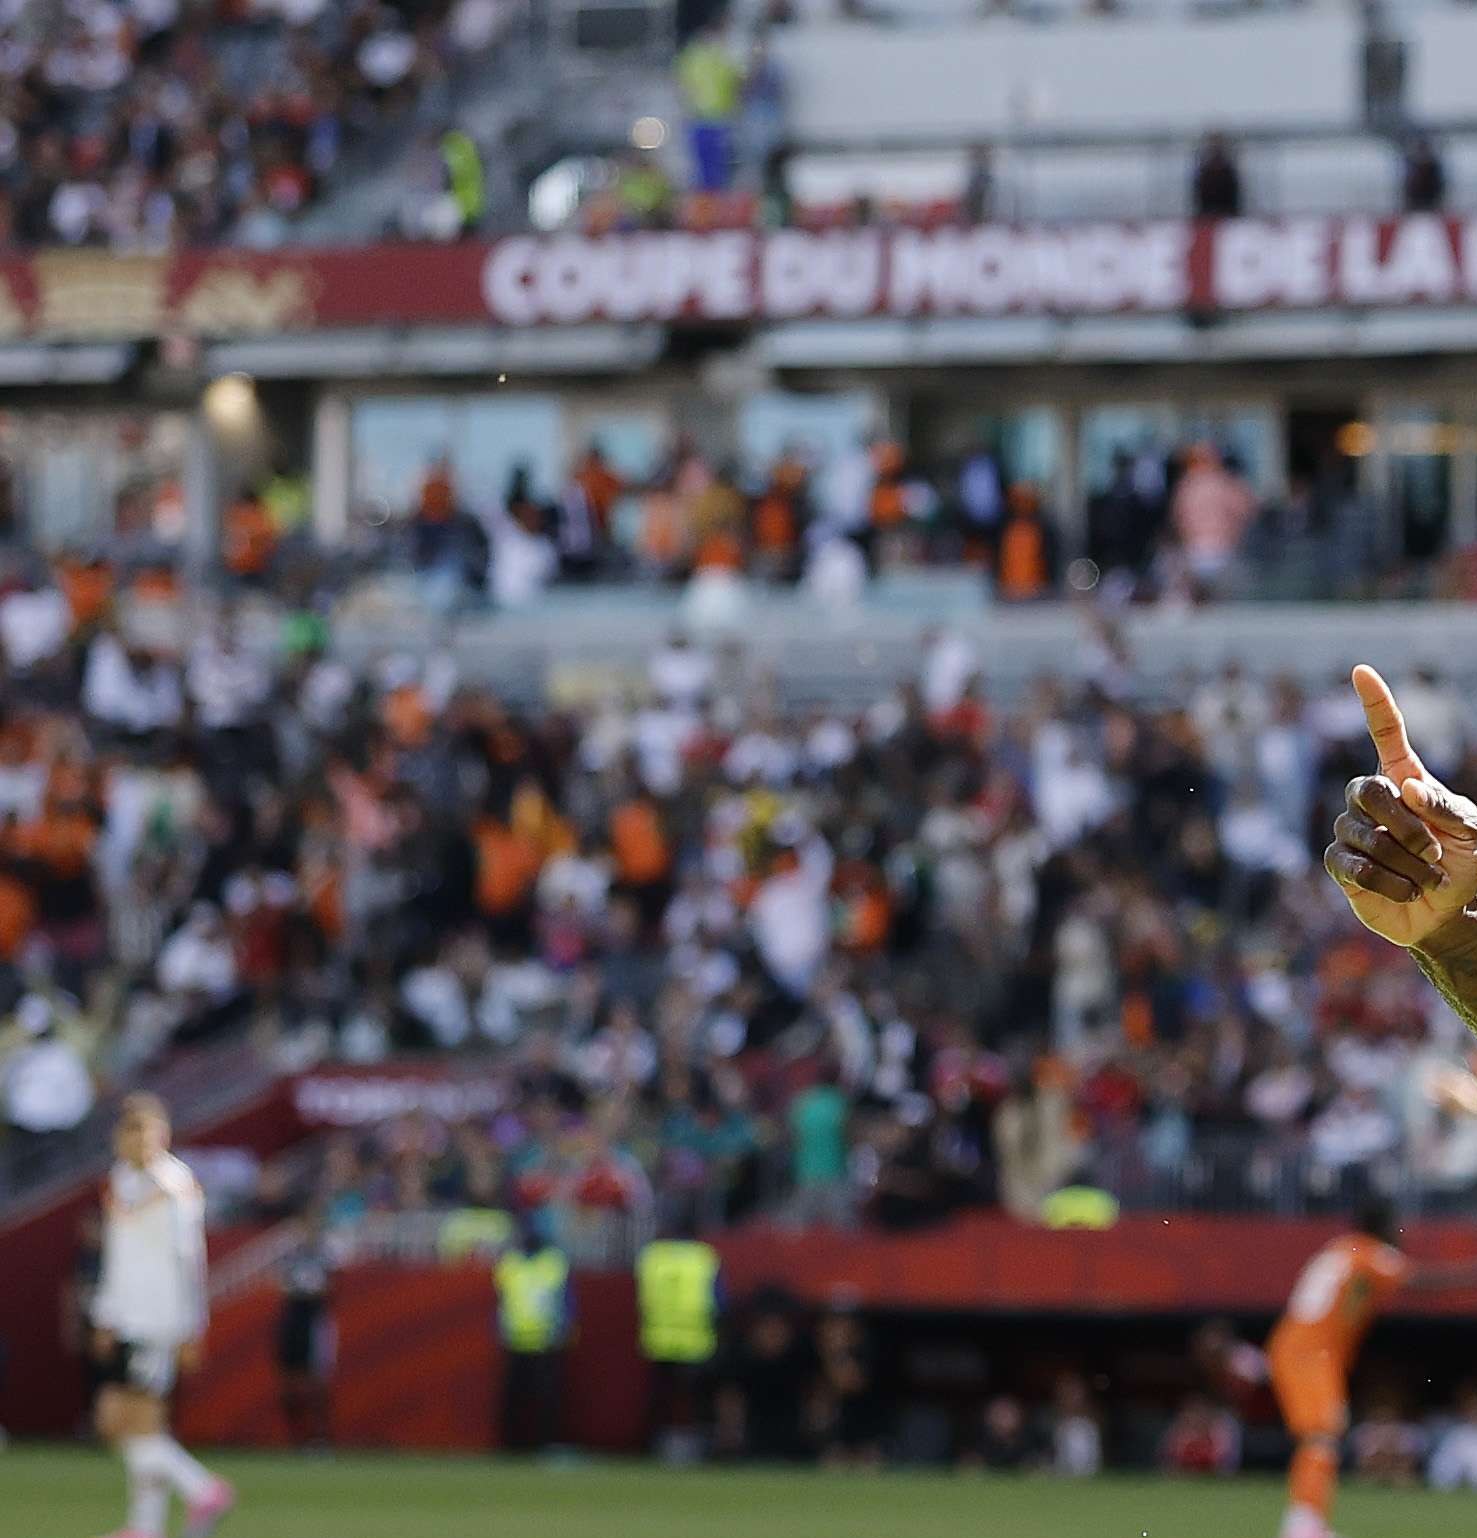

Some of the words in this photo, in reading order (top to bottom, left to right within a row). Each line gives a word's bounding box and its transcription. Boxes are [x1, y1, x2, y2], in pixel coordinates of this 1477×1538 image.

[484, 230, 754, 324] COUPE
[760, 228, 881, 317] DU
[888, 222, 1192, 314] MONDE
[1214, 216, 1328, 306] DE
[1337, 212, 1456, 304] LA
